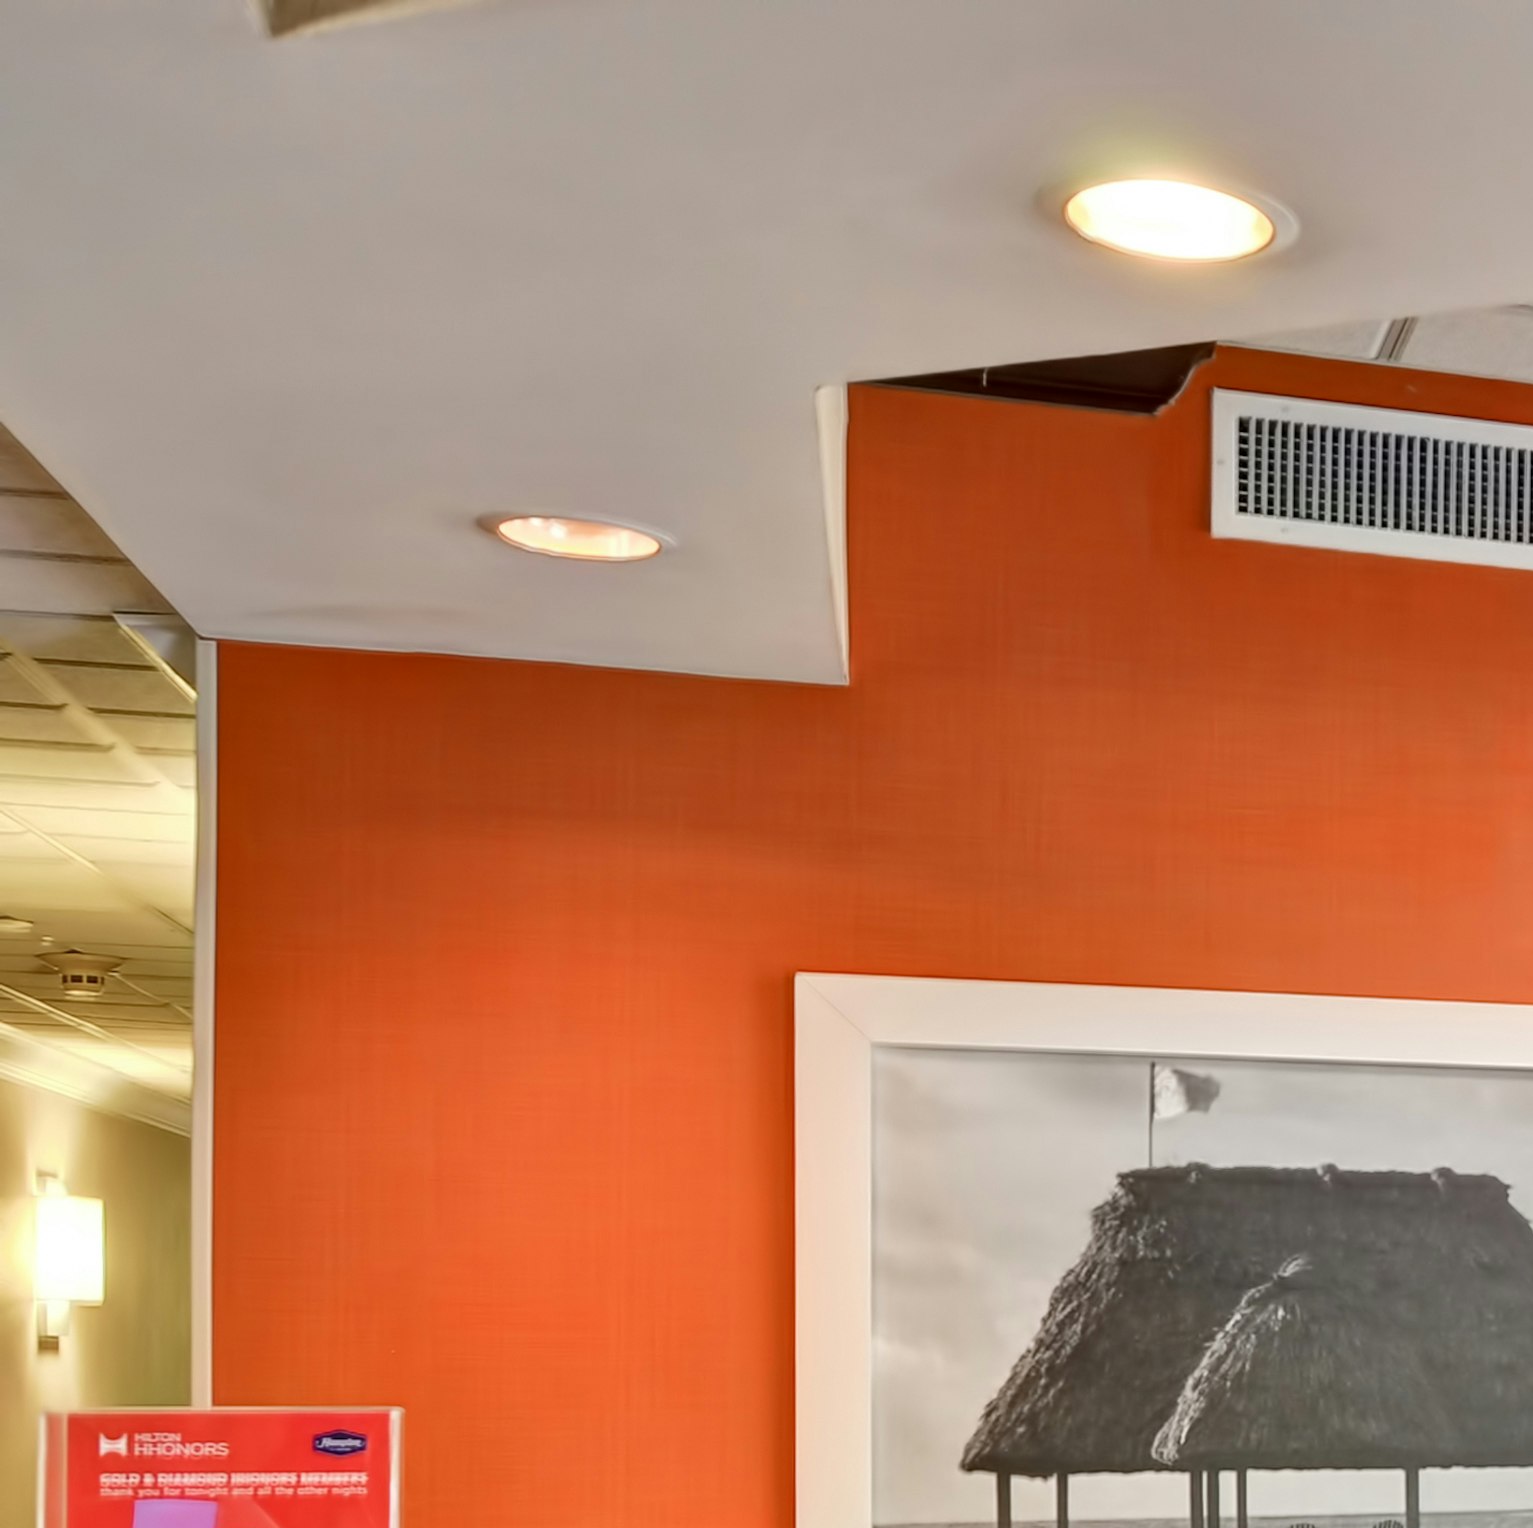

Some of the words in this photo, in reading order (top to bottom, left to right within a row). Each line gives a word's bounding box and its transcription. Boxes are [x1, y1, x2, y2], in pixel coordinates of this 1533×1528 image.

[134, 1432, 182, 1443] HILTON
[134, 1442, 230, 1457] HHONORS
[99, 1472, 141, 1488] GOLD
